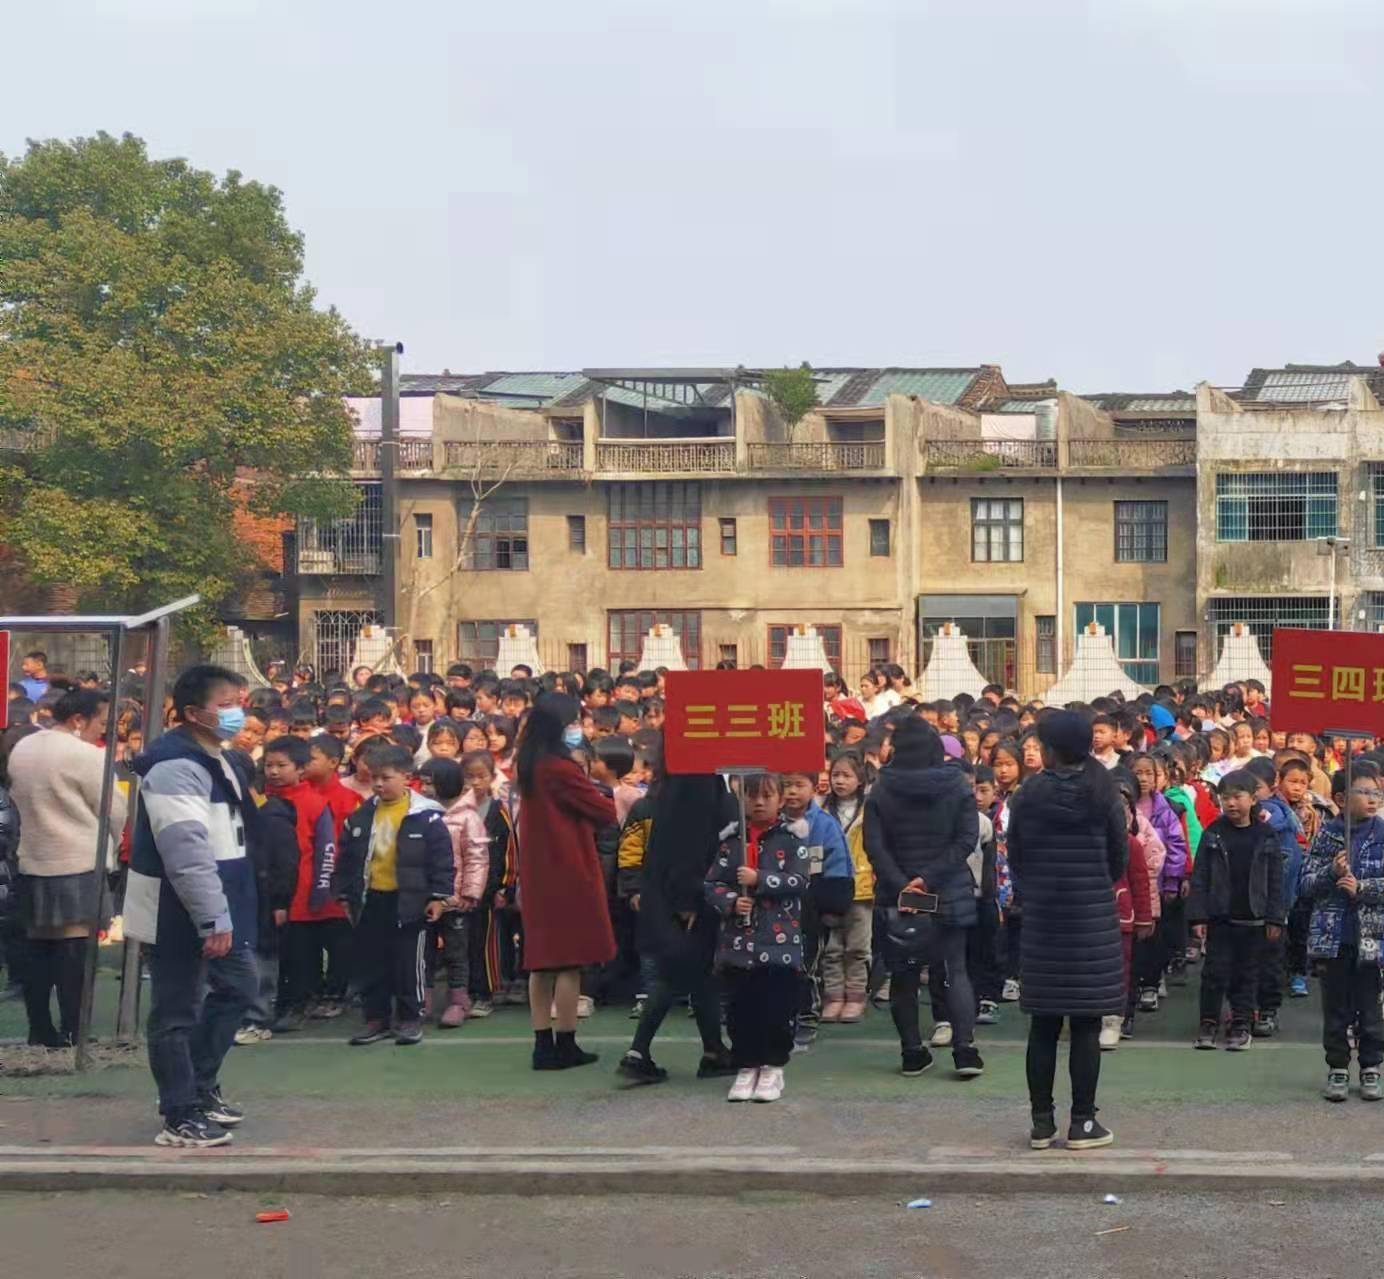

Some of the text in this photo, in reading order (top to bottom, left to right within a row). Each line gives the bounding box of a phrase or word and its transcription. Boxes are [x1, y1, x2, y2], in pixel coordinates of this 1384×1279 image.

[683, 701, 805, 739] 三三班
[317, 842, 336, 889] CHINA
